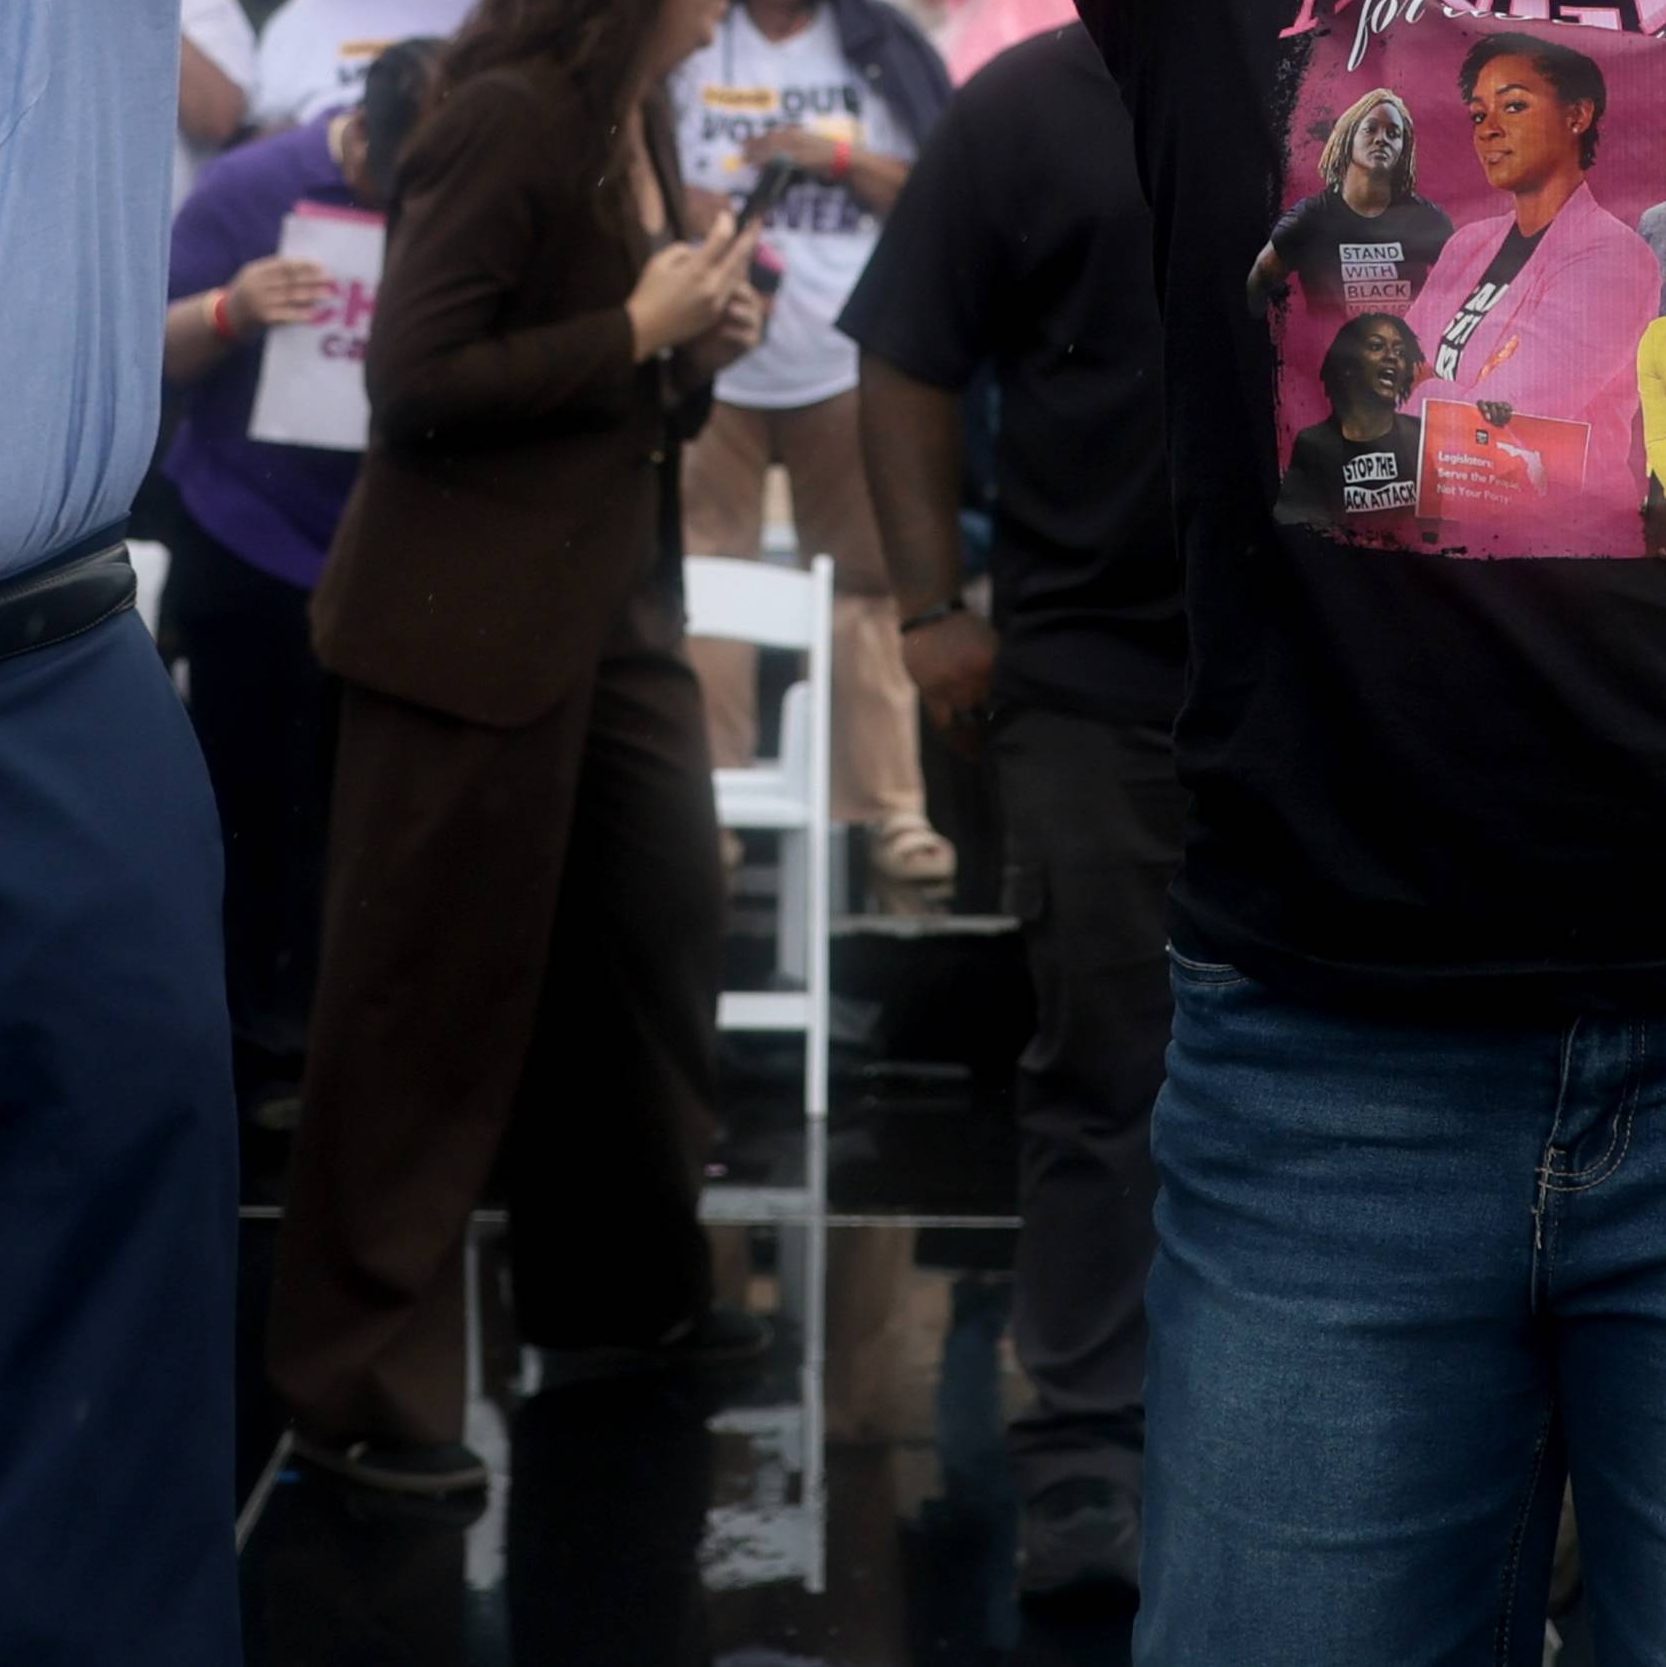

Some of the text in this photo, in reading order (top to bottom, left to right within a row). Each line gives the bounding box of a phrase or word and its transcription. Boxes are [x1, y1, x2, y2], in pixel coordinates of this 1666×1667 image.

[1343, 246, 1400, 260] STAND
[1345, 265, 1395, 278] WITH
[1347, 284, 1407, 298] BLACK
[1345, 456, 1396, 481] STOP THE
[1437, 467, 1469, 481] Serve
[1470, 472, 1487, 484] the
[1346, 483, 1417, 510] ACK ATTACK
